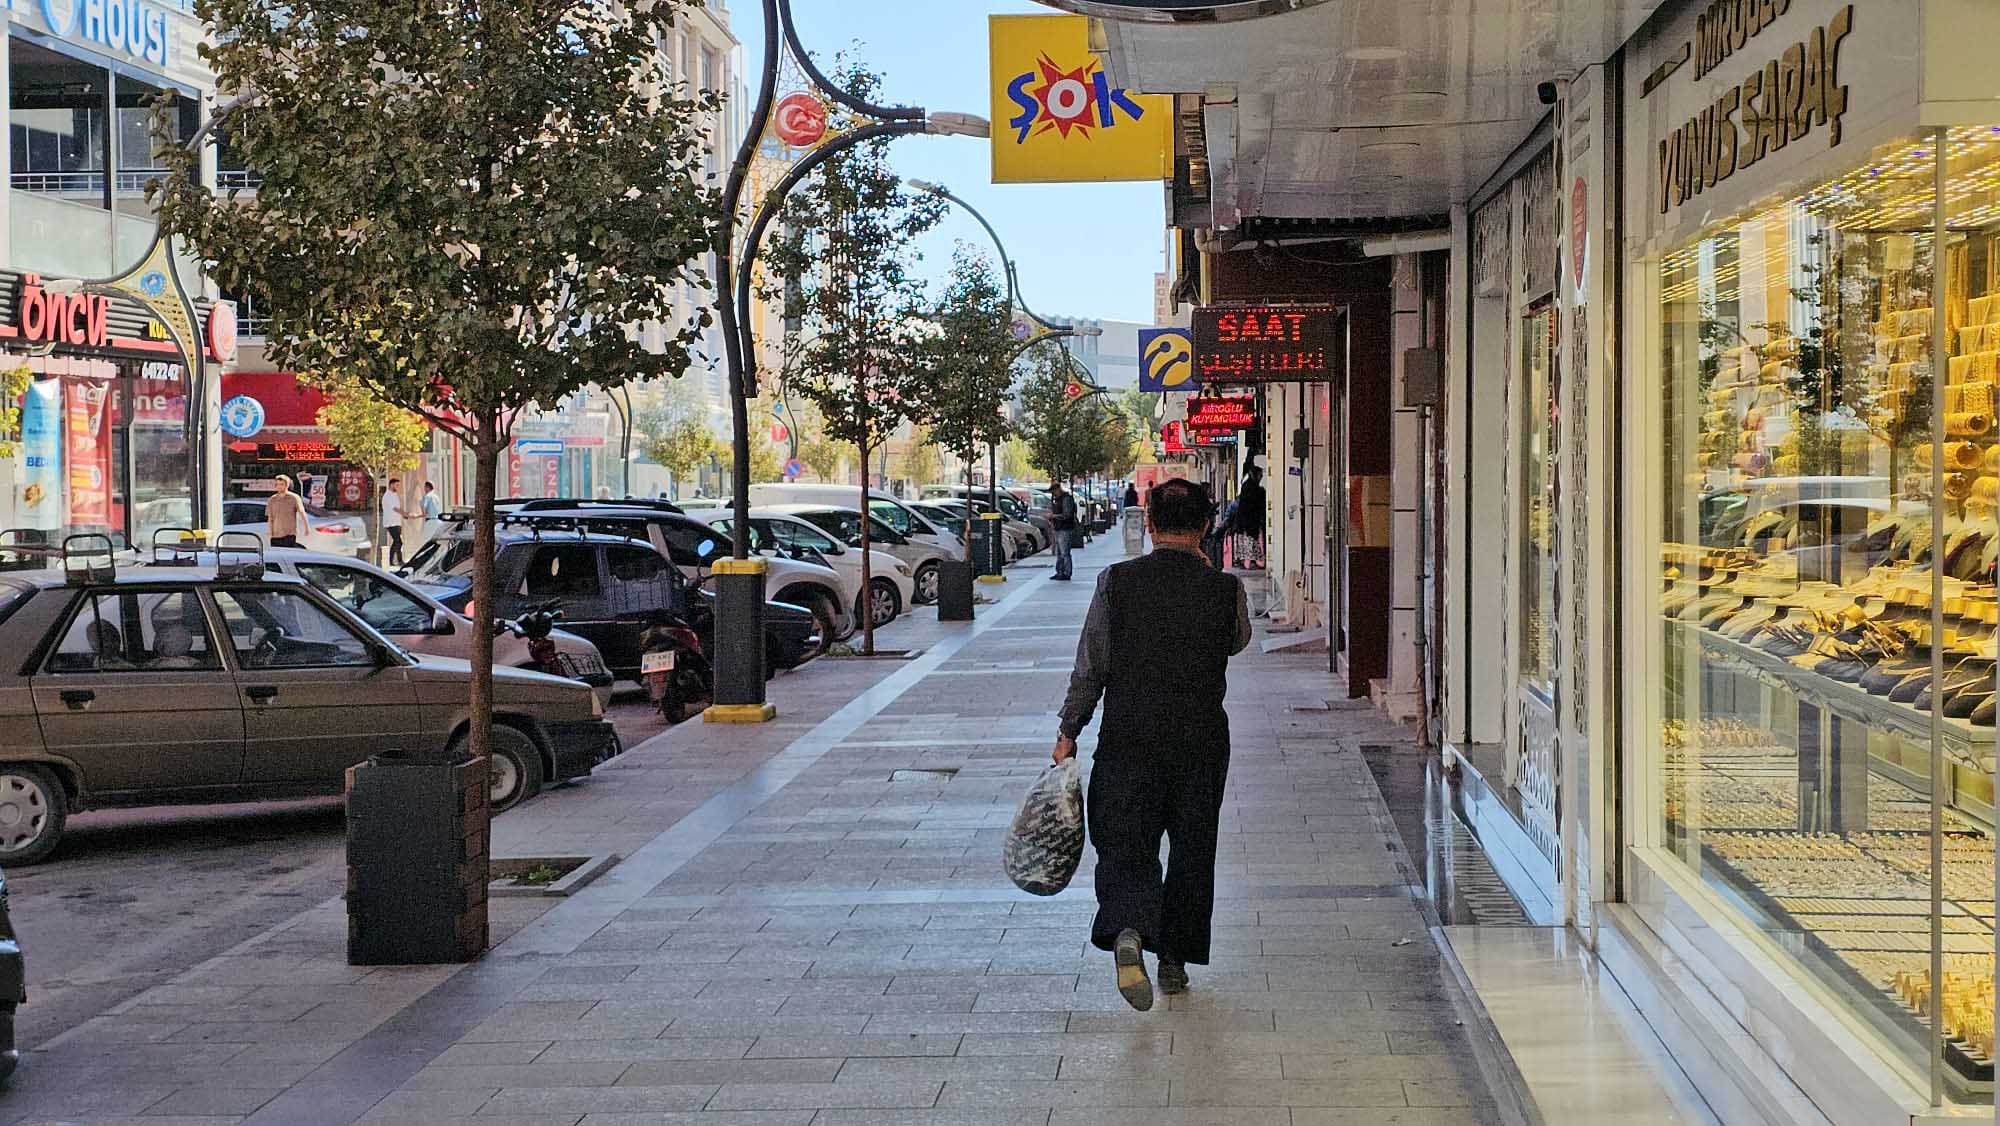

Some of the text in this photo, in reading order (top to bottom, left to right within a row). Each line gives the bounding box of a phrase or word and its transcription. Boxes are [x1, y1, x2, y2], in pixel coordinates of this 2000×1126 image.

[1658, 4, 1854, 214] YUNUS SARAÇ
[1217, 313, 1307, 342] SAAT
